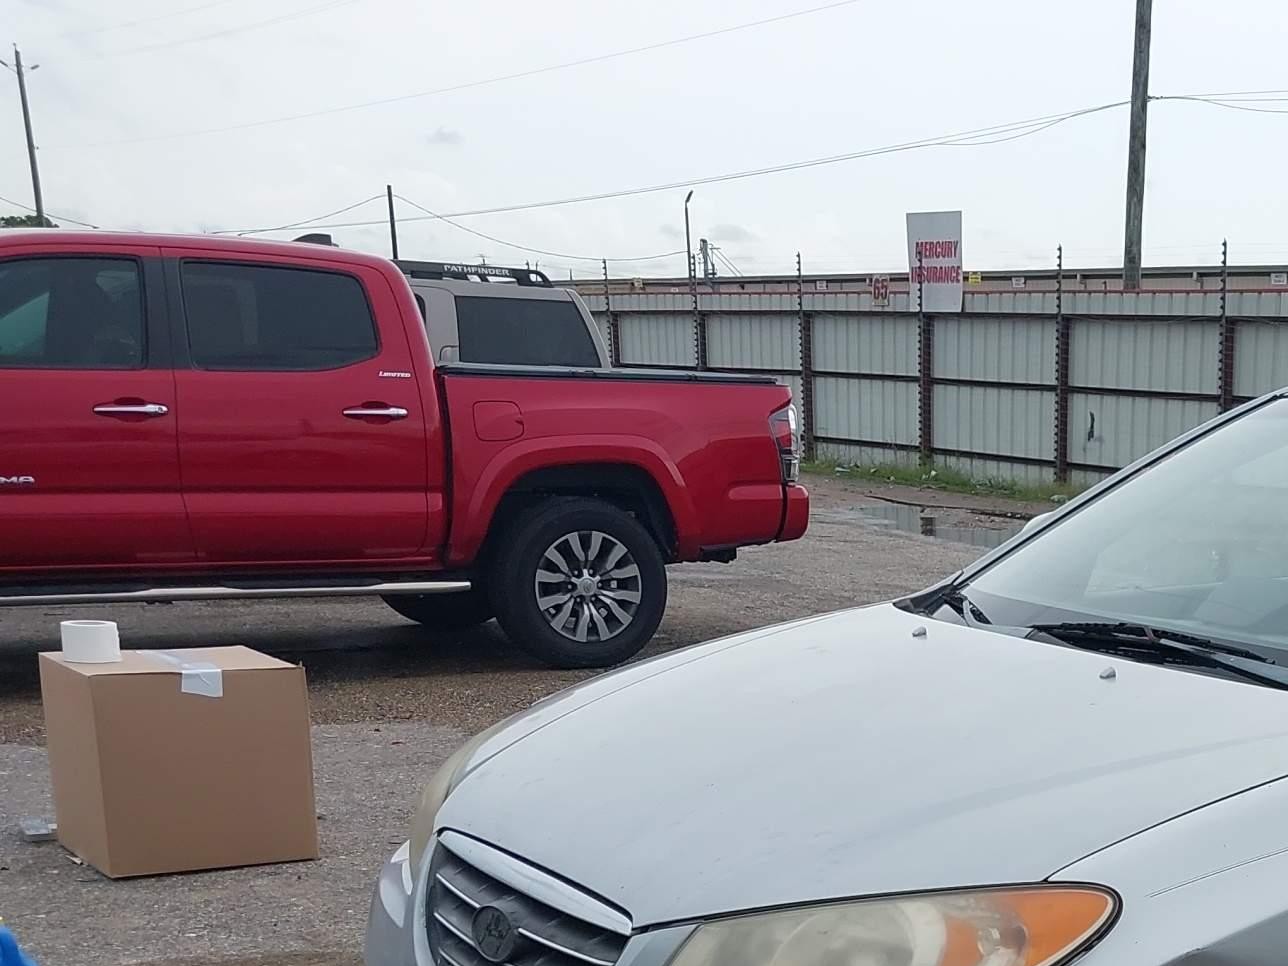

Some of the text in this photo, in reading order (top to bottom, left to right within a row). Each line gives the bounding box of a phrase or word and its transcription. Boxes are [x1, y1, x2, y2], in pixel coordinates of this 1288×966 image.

[915, 240, 959, 258] MERCURY
[443, 264, 510, 276] PATHFINDER
[873, 278, 888, 300] 65
